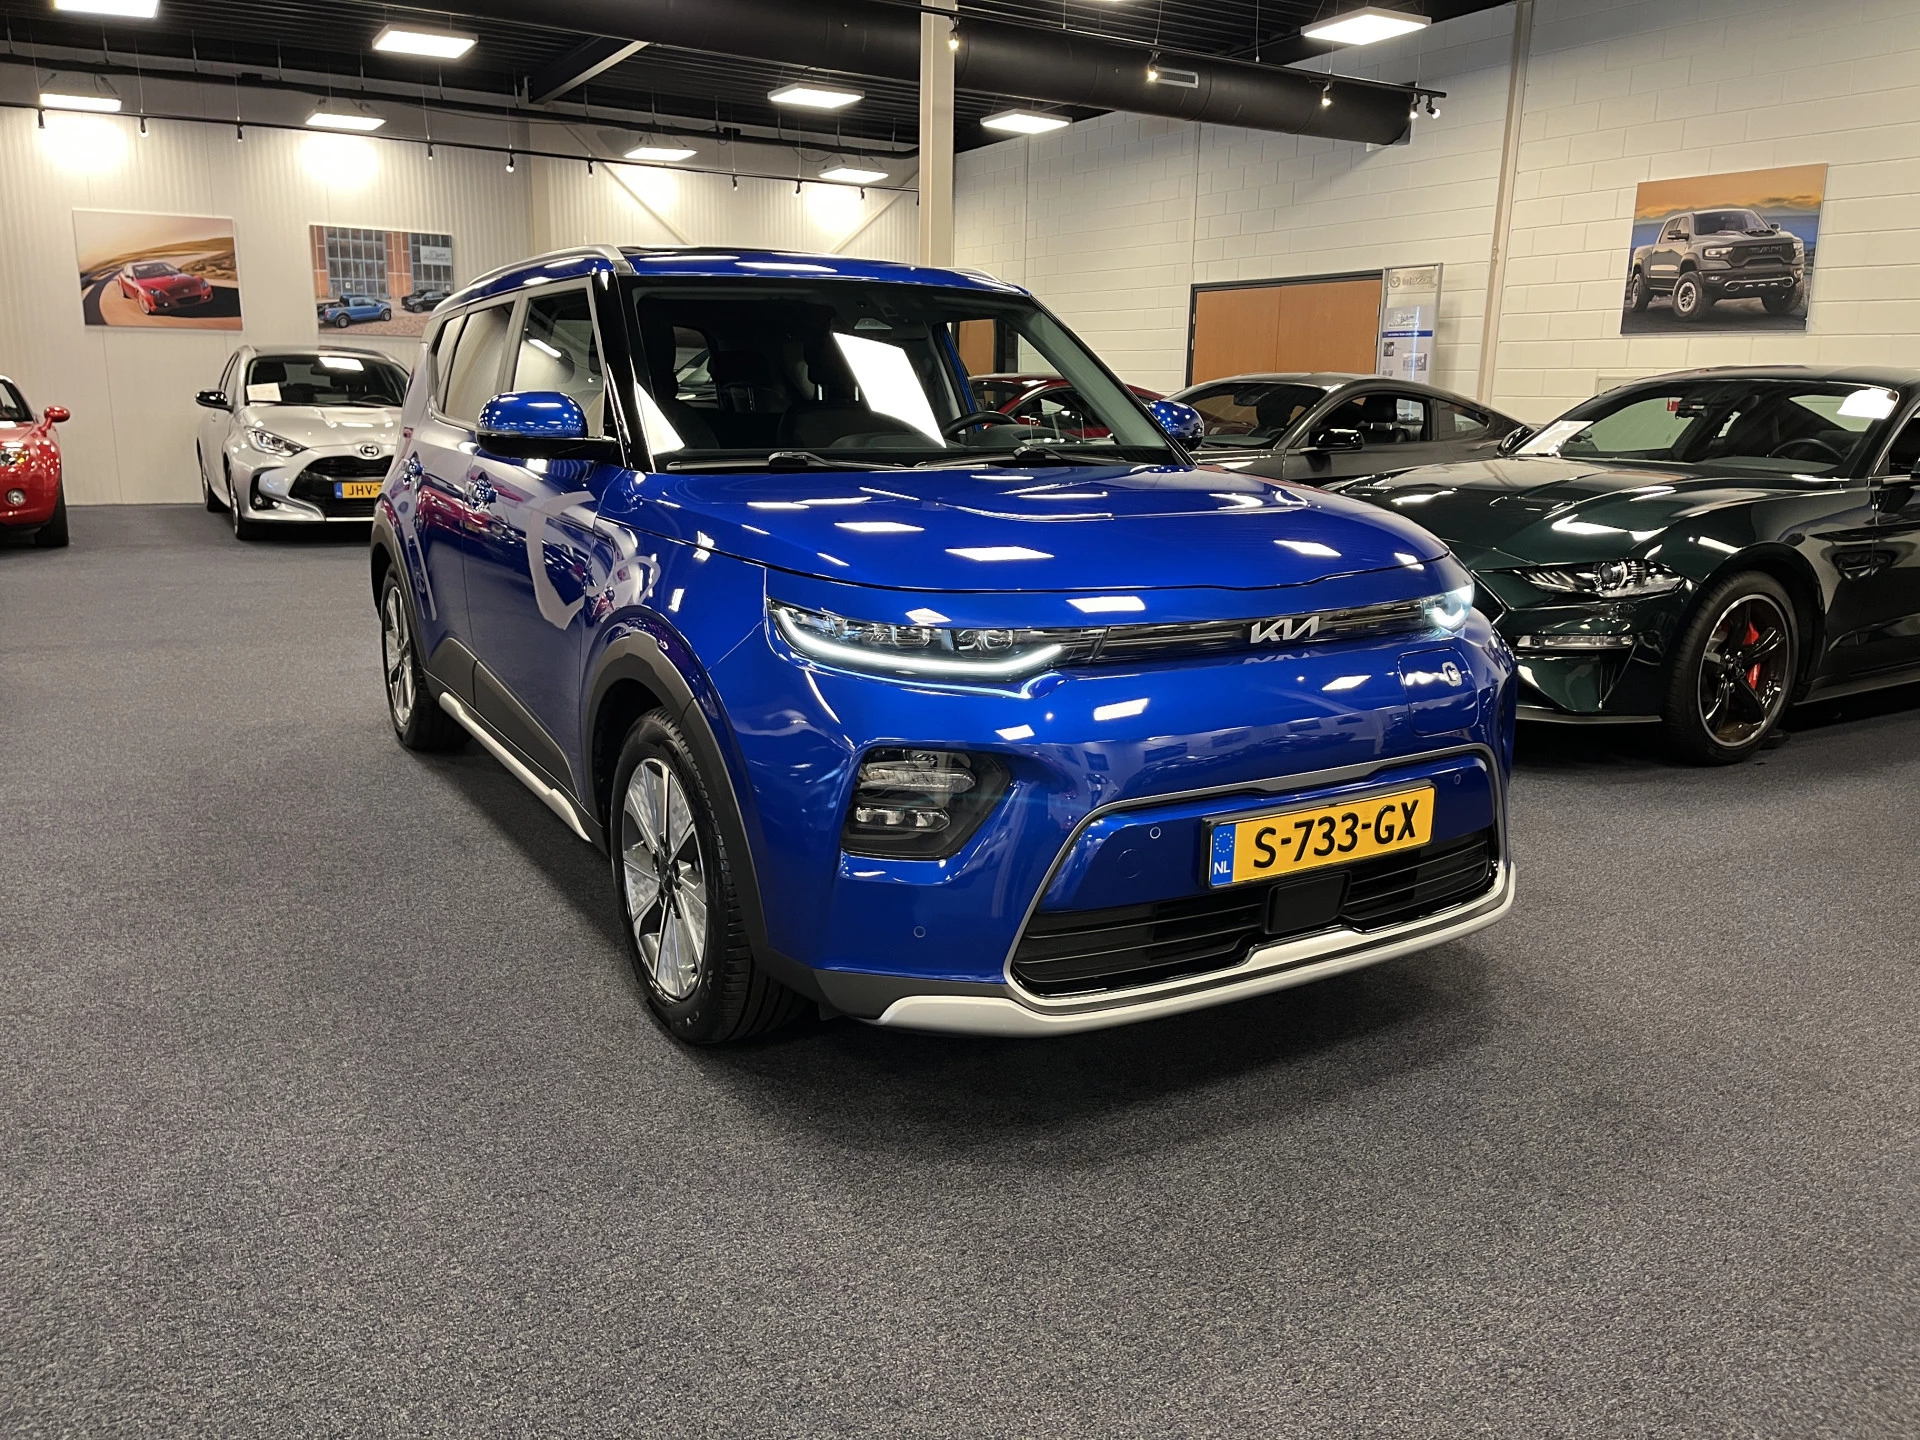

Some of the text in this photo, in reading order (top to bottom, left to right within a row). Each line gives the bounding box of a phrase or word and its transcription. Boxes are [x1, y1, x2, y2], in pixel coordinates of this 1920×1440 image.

[1250, 616, 1320, 643] KIA
[1253, 800, 1419, 869] S-733-GX
[1214, 861, 1231, 875] NL
